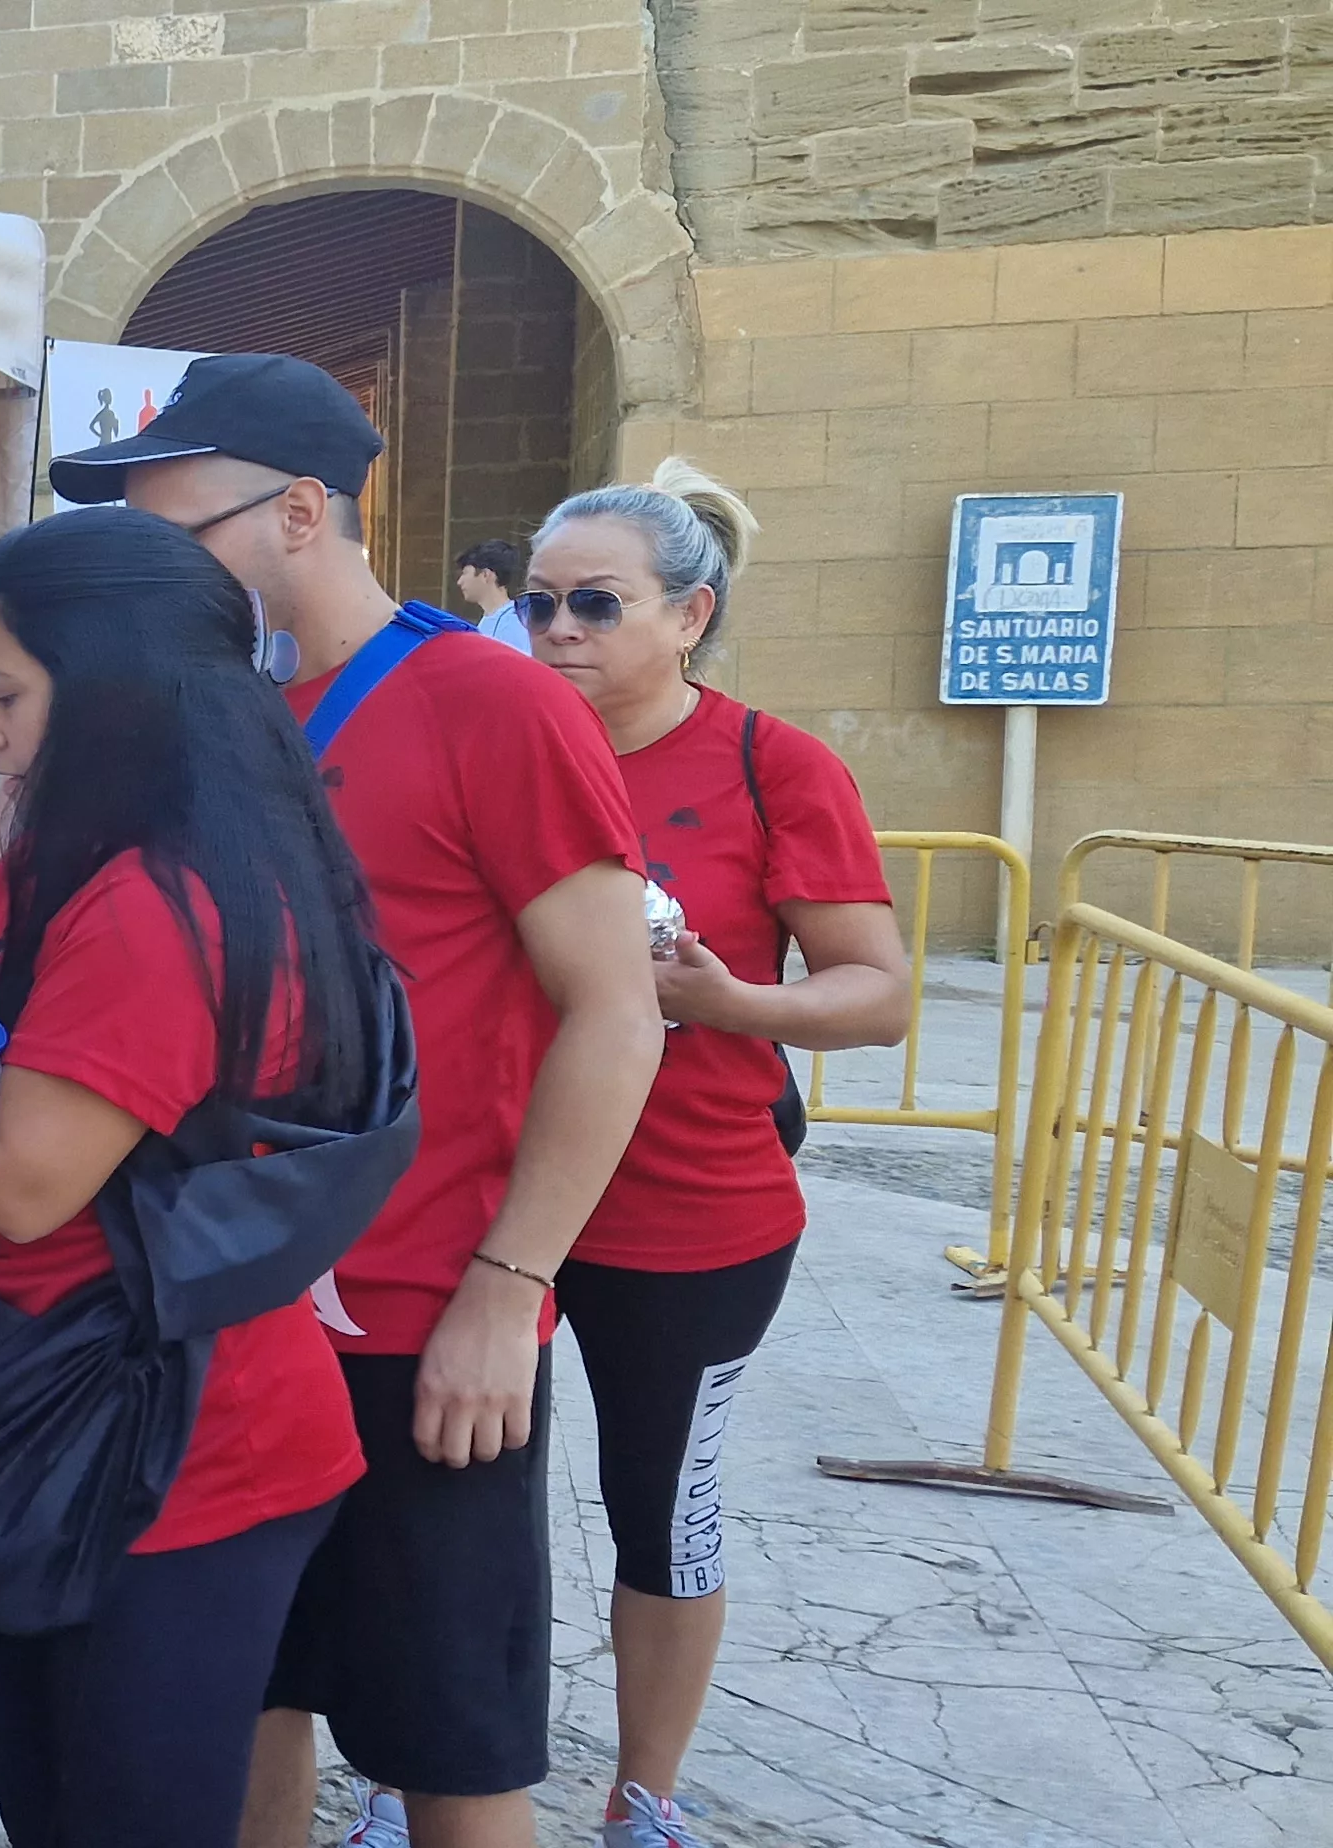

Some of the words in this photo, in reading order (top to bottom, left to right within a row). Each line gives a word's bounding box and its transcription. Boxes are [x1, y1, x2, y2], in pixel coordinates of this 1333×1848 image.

[959, 618, 1100, 639] SANTUARIO
[958, 645, 989, 665] DE
[960, 671, 990, 691] DE
[1001, 671, 1090, 691] SALAS
